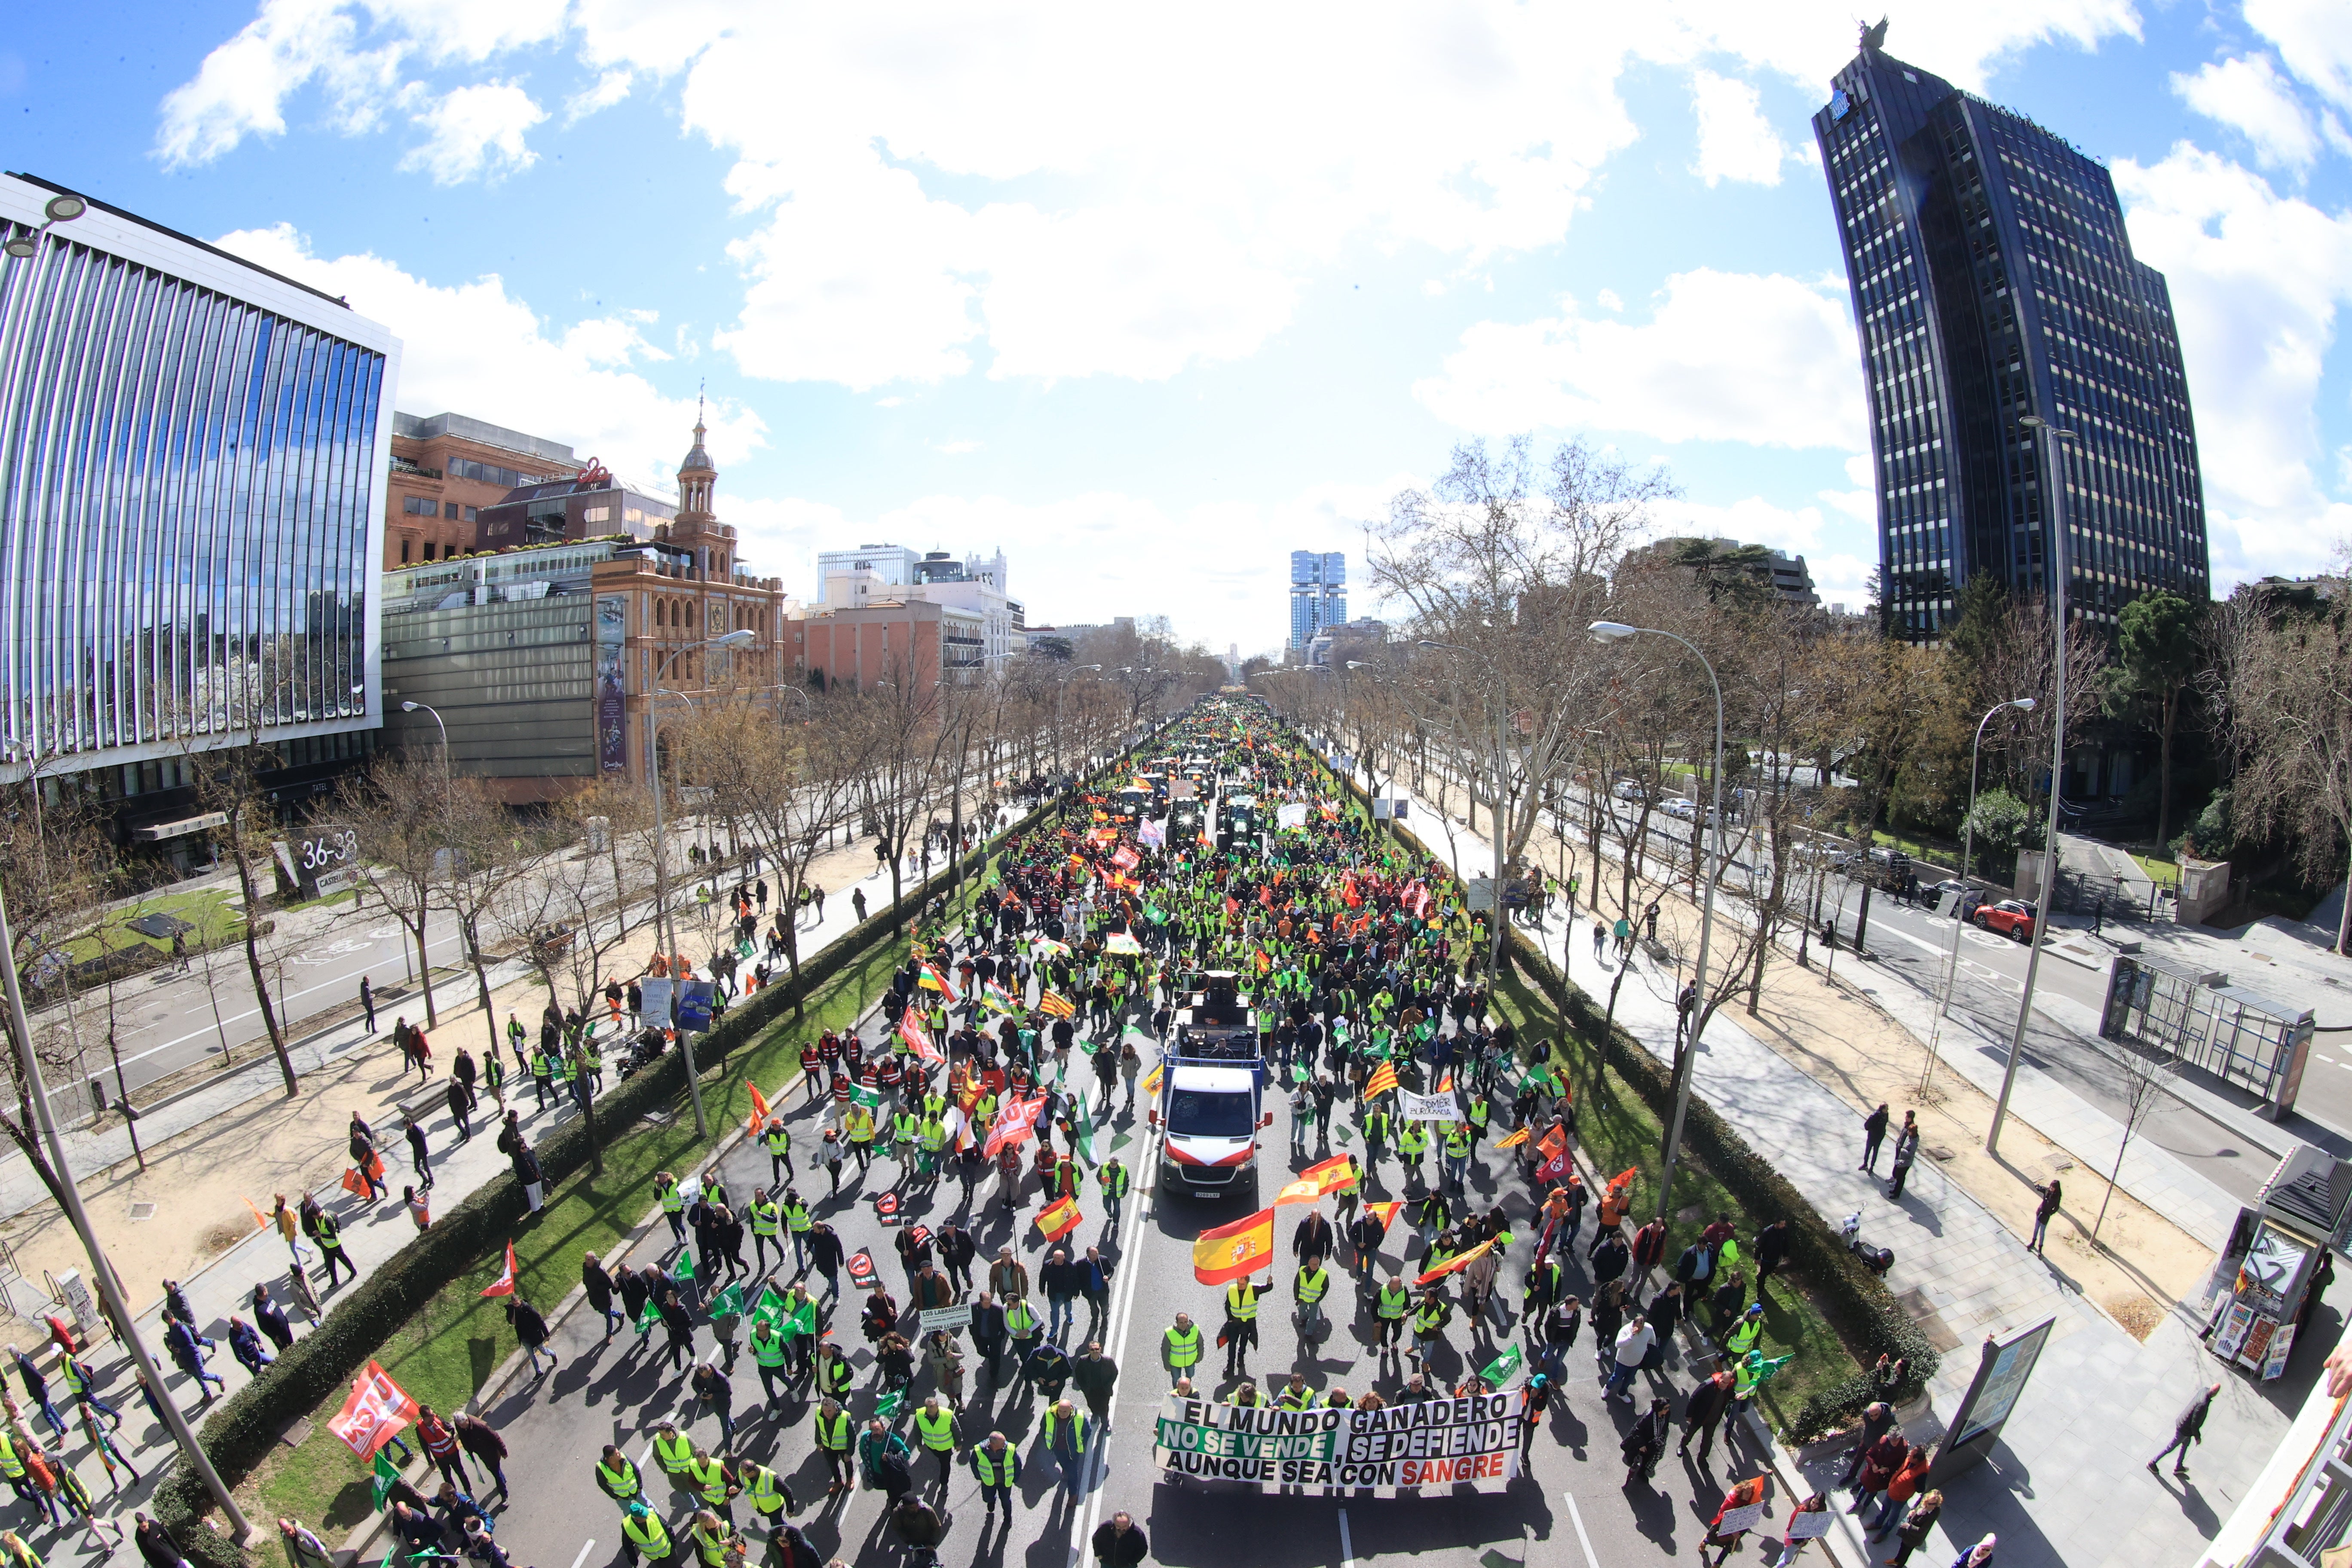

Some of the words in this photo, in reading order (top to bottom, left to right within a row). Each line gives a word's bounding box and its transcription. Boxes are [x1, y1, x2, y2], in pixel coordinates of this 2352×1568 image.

[303, 830, 357, 869] 36-38
[934, 1305, 969, 1315] LABRADORES
[944, 1320, 971, 1329] LLORANDO
[1184, 1401, 1218, 1428] EL
[1228, 1408, 1340, 1435] MUNDO
[1351, 1394, 1506, 1433] GANADERO
[1163, 1422, 1199, 1449] NO
[1204, 1430, 1236, 1455] SE
[1351, 1435, 1387, 1461] SE
[1390, 1418, 1518, 1459] DEFIENDE
[1166, 1451, 1276, 1480] AUNQUE
[1282, 1461, 1332, 1484] SEA
[1340, 1462, 1396, 1485] CON
[1402, 1452, 1504, 1485] SANGRE
